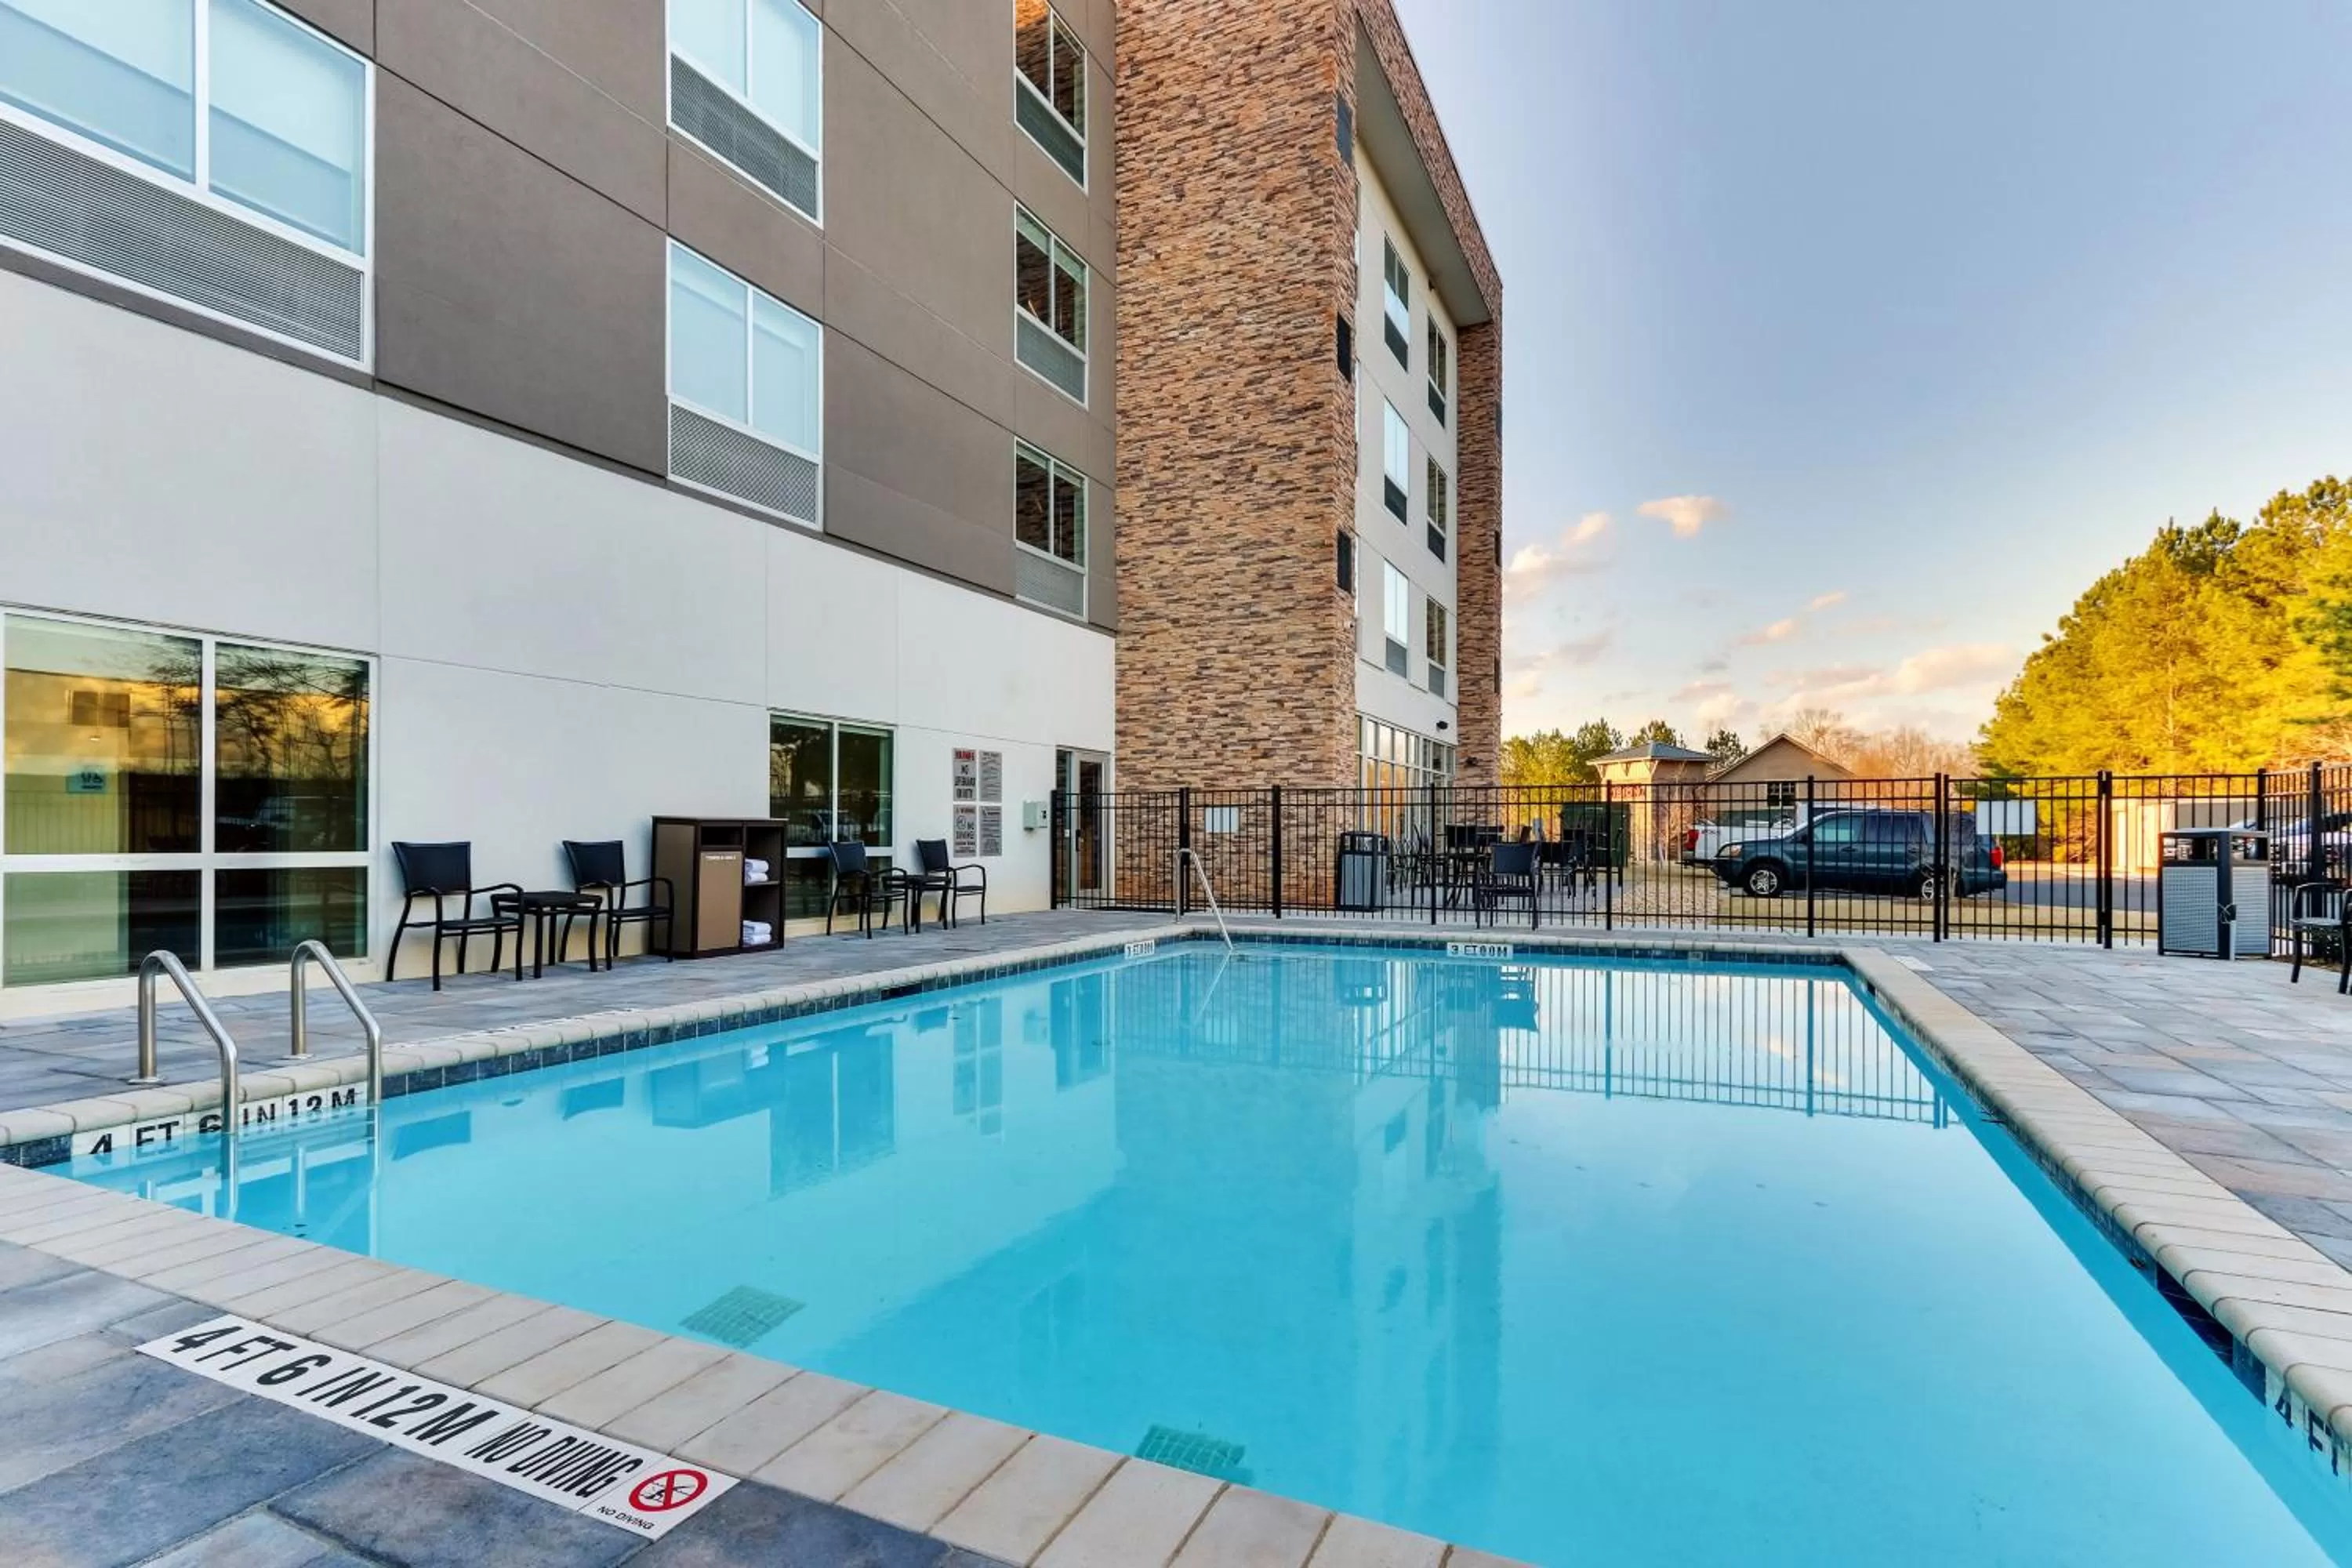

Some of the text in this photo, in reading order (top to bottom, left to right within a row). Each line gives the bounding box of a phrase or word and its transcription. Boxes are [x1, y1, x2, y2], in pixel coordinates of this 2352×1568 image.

[136, 1120, 180, 1146] FT
[243, 1103, 275, 1125] IN
[170, 1326, 243, 1353] 4
[194, 1335, 298, 1371] FT
[256, 1354, 332, 1385] 6
[295, 1367, 396, 1407] IN
[464, 1421, 552, 1463] NO
[506, 1436, 644, 1498] DIVING
[597, 1505, 655, 1530] NO DIVING
